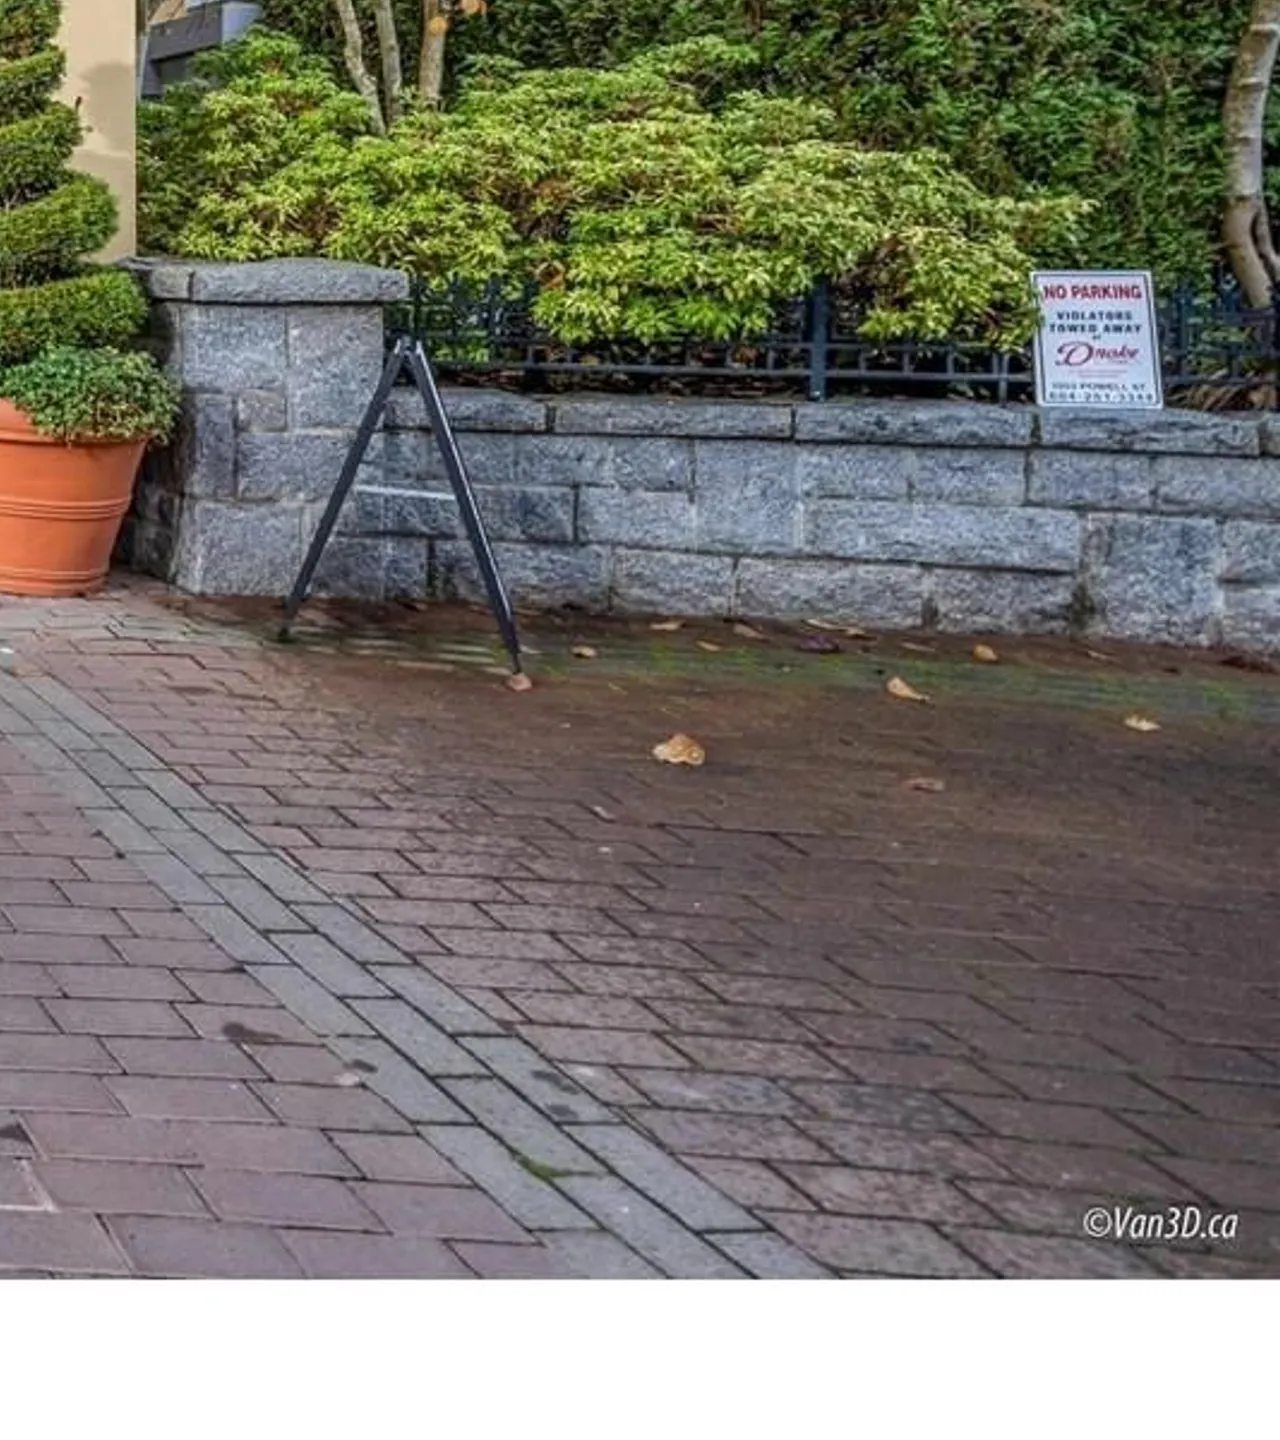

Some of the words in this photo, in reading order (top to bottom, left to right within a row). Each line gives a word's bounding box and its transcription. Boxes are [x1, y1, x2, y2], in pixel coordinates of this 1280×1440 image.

[1043, 285, 1068, 299] NO
[1071, 285, 1142, 299] PARKING
[1056, 311, 1132, 320] VIOLATORS
[1049, 324, 1098, 332] TOWED
[1103, 324, 1142, 332] AWAY
